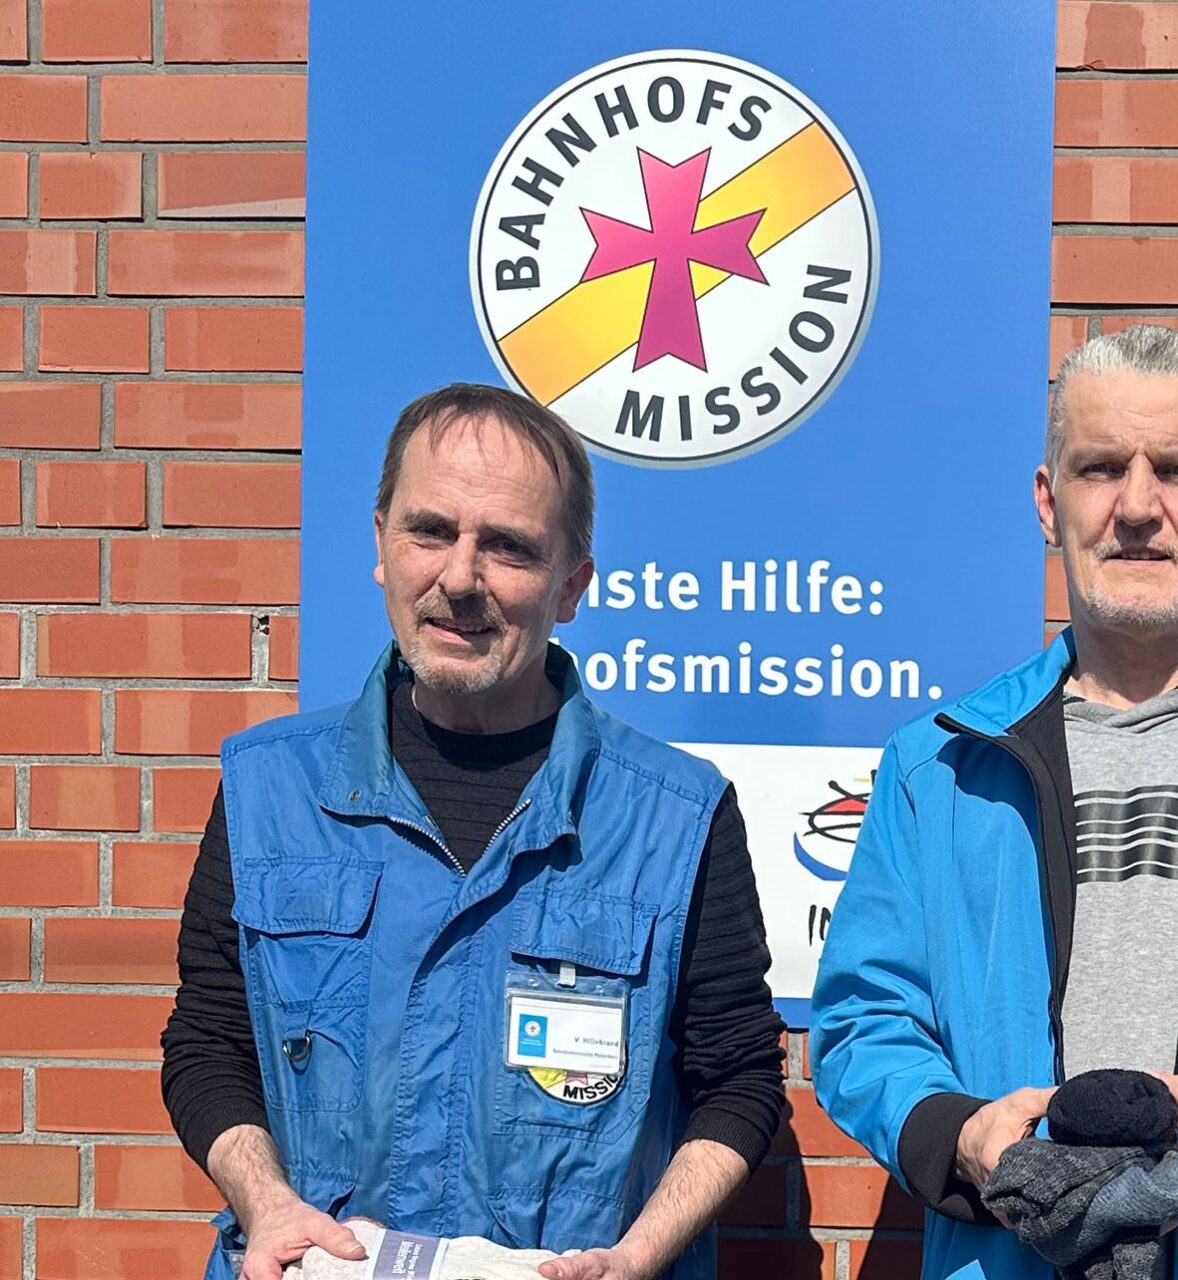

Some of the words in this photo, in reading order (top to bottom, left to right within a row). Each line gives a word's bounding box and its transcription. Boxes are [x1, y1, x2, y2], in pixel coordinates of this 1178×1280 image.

[496, 76, 772, 291] BAHNHOFS
[615, 264, 852, 442] MISSION
[721, 559, 884, 616] Hilfe:
[549, 637, 943, 700] ofsmission.
